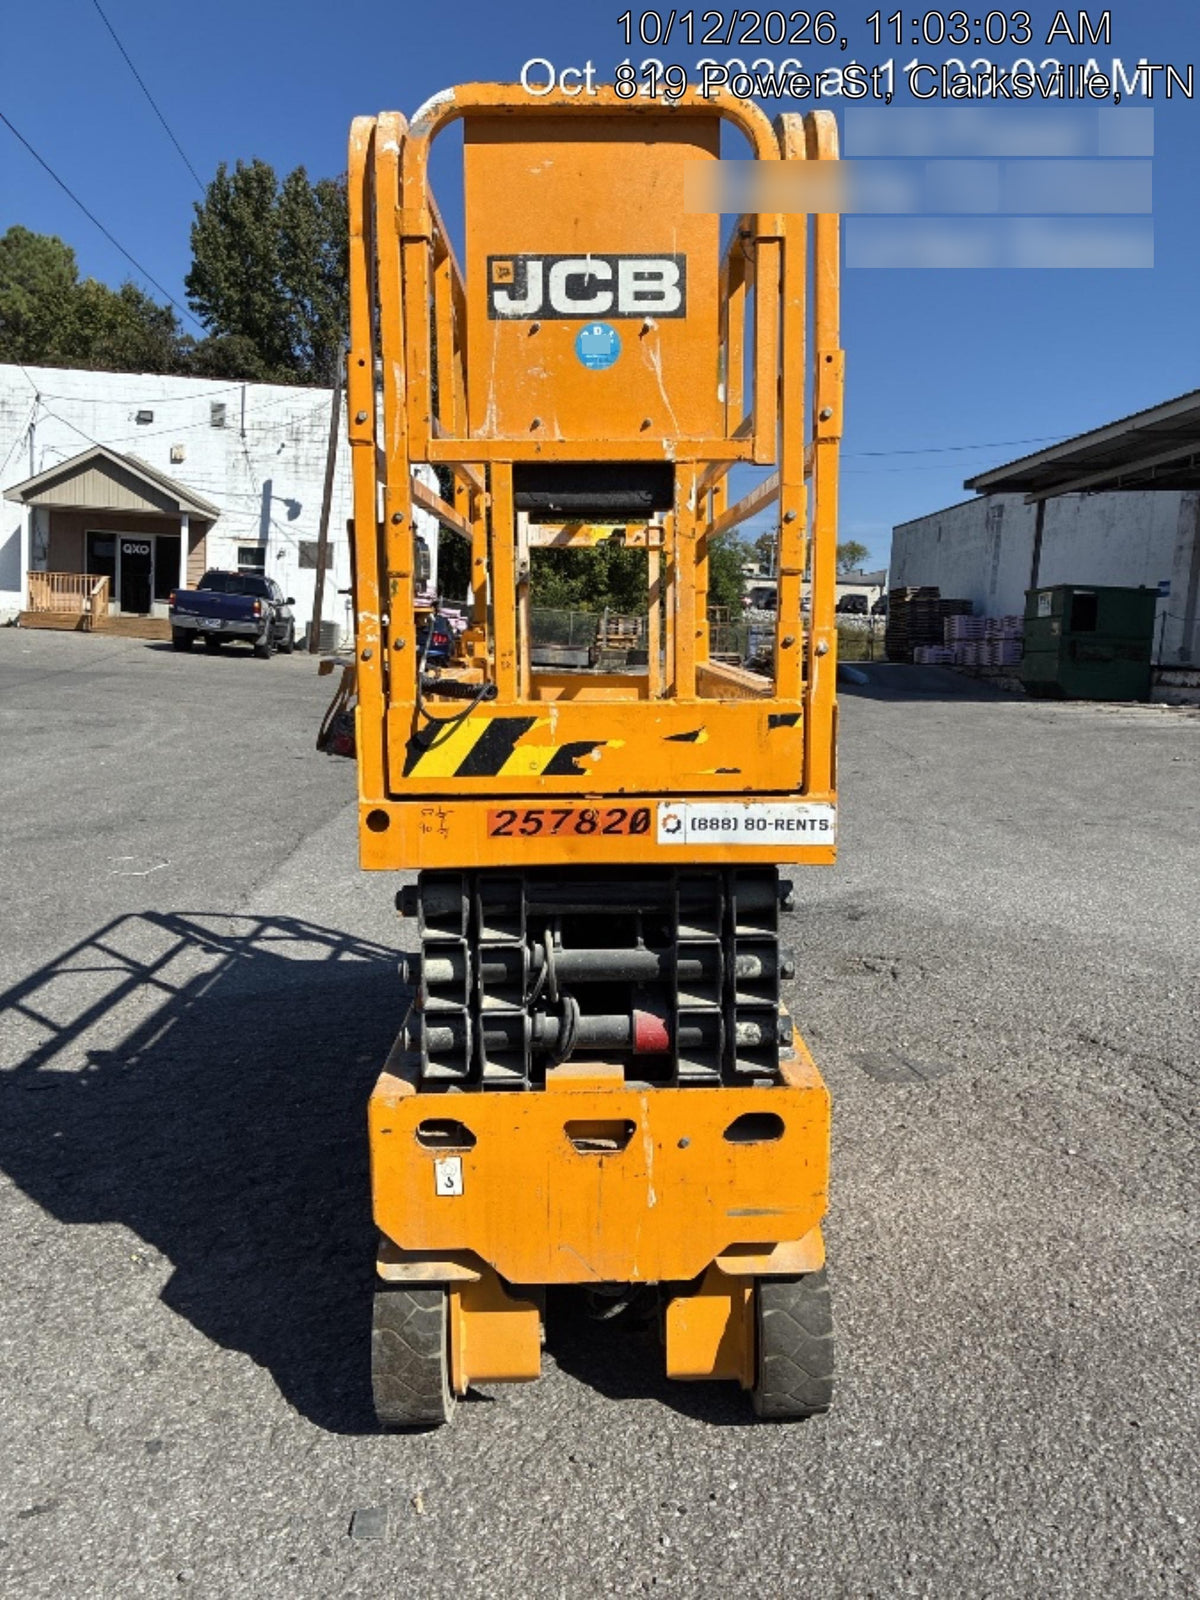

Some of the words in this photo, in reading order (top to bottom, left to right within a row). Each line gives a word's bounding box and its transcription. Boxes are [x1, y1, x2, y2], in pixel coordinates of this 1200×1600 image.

[493, 258, 682, 314] JCB
[122, 543, 150, 555] QXO
[490, 807, 651, 836] 257820
[744, 817, 829, 832] 80-RENTS
